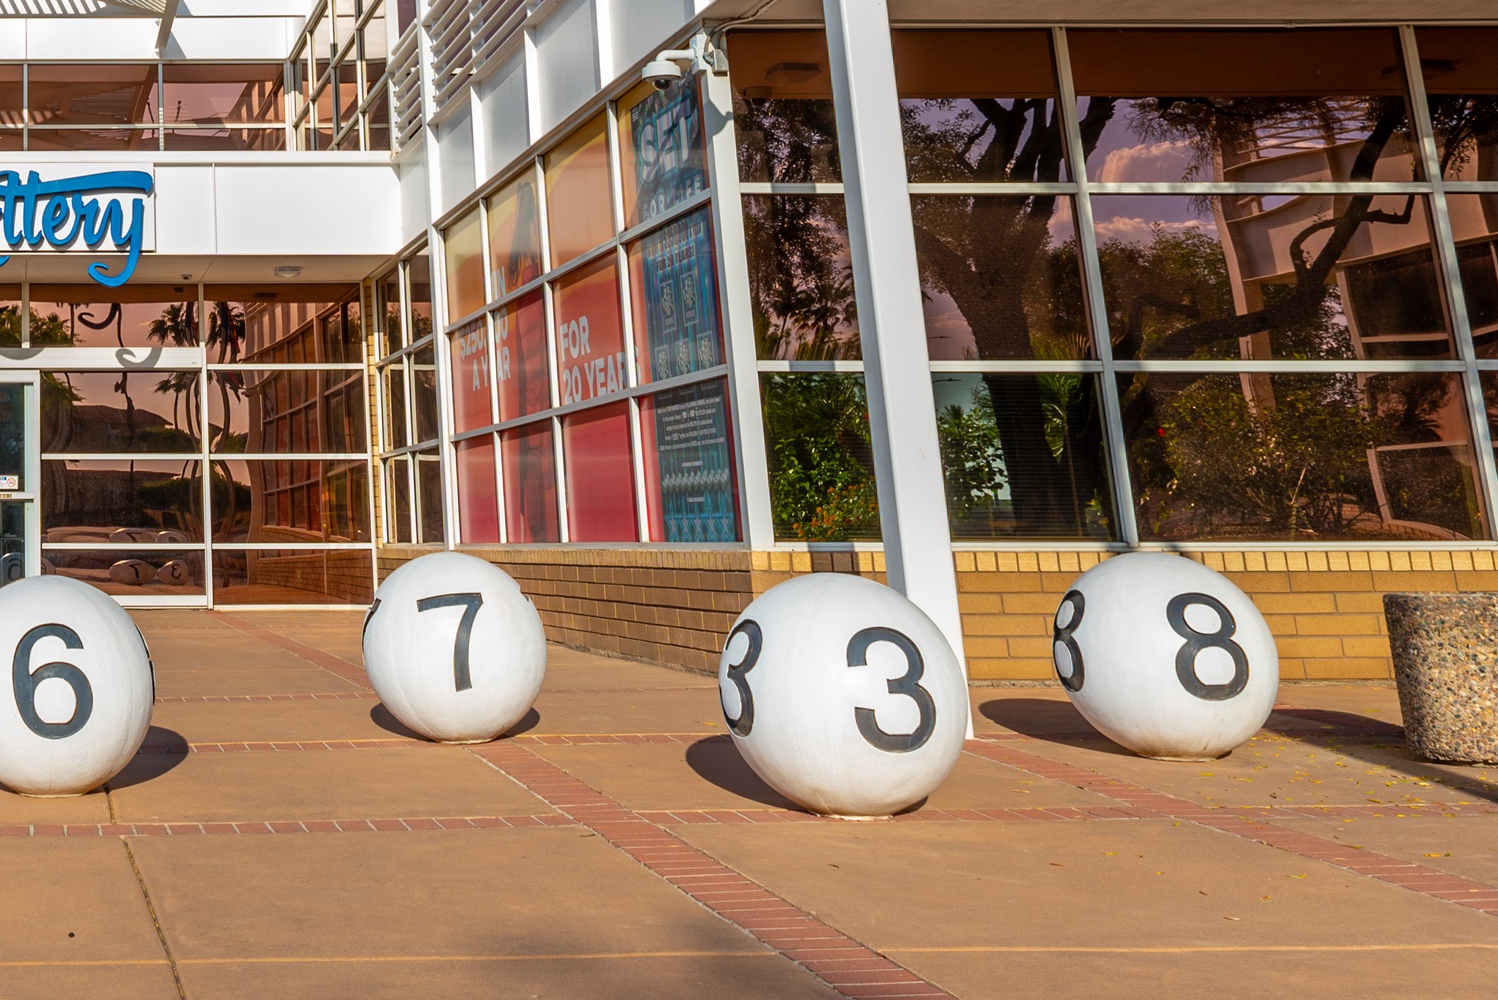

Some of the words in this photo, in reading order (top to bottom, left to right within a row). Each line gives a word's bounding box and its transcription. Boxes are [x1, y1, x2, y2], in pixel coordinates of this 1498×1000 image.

[640, 98, 692, 184] SET
[460, 306, 510, 361] $250,00
[472, 359, 481, 392] A
[481, 346, 512, 388] YAR
[559, 315, 591, 363] FOR
[563, 365, 583, 406] 20
[12, 622, 94, 740] 6
[416, 592, 484, 692] 7
[719, 618, 763, 737] 3
[846, 626, 937, 753] 3
[1052, 589, 1086, 693] 8
[1166, 592, 1250, 701] 8
